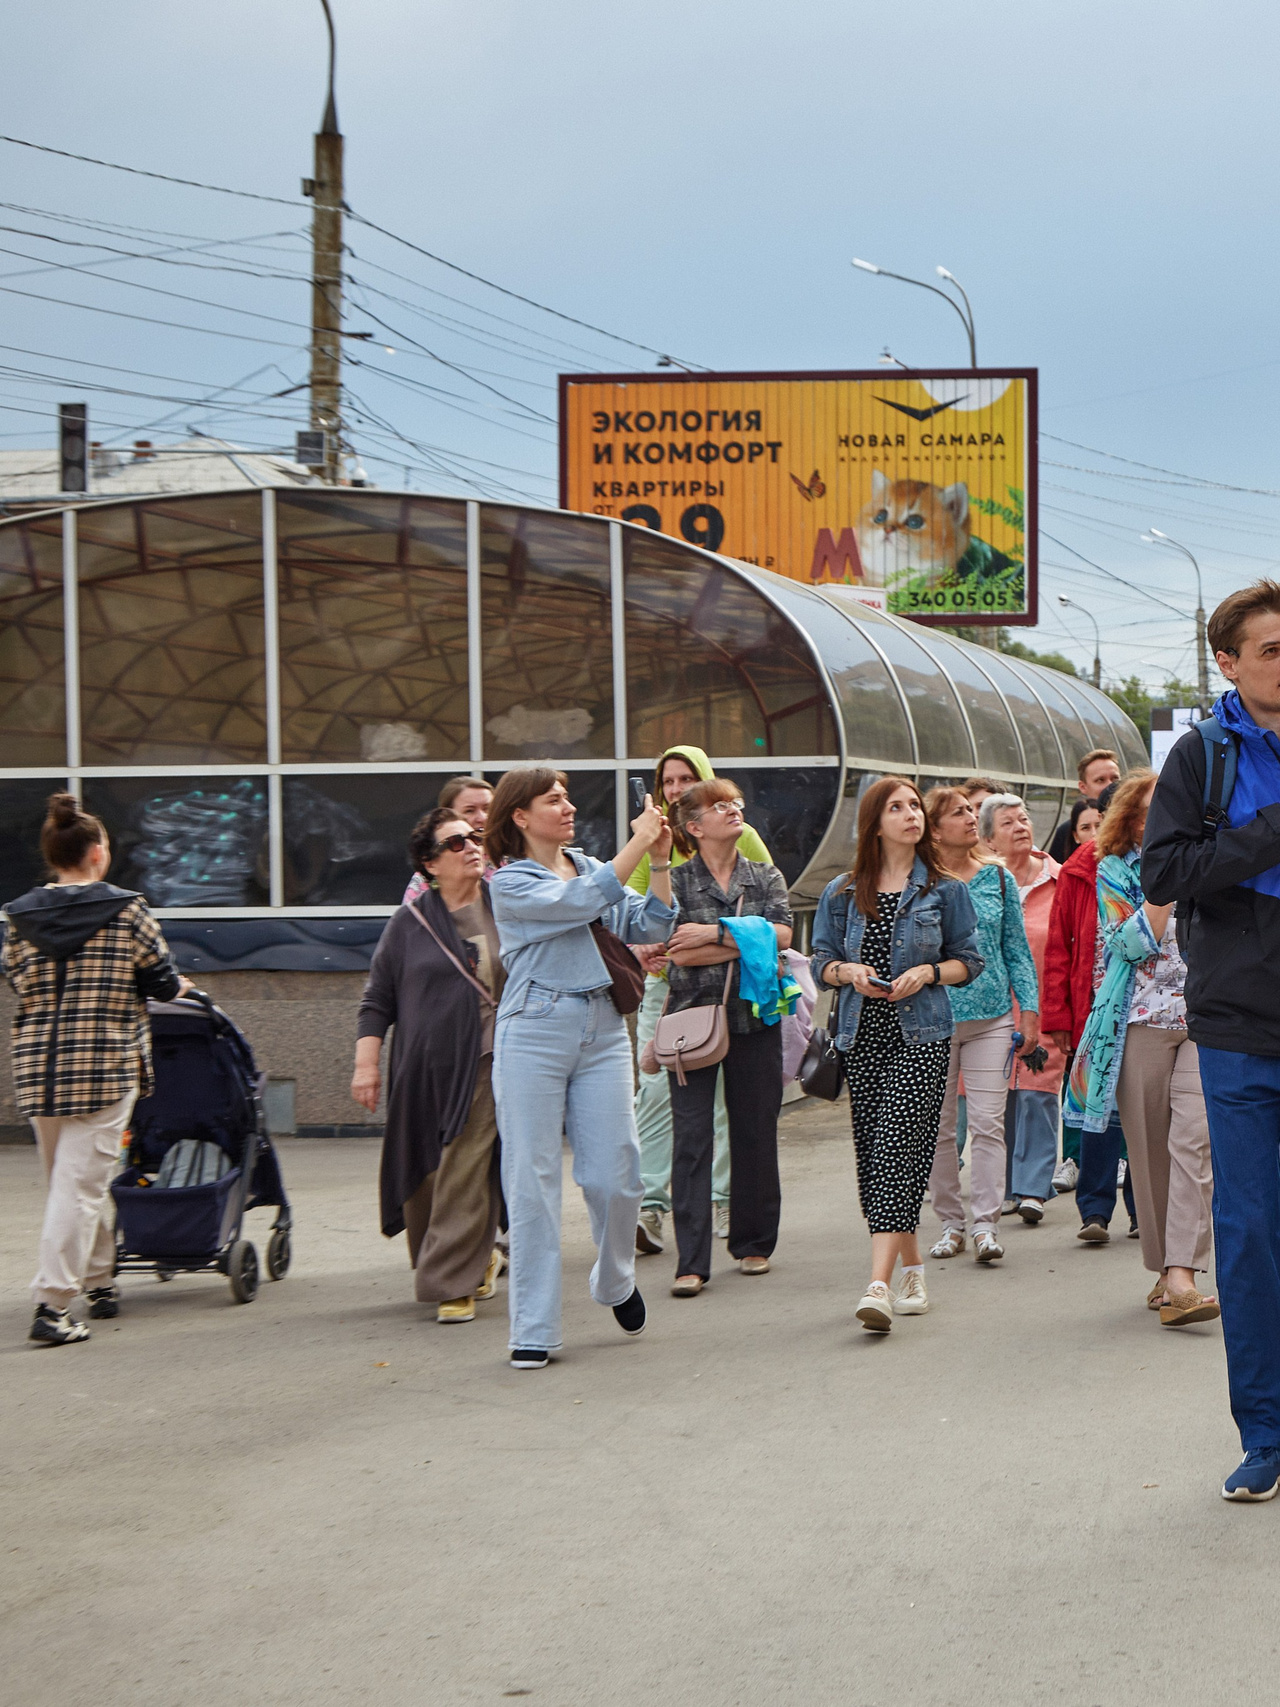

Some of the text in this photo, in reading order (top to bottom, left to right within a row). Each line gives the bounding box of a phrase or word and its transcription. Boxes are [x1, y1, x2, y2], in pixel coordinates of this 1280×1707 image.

[592, 410, 762, 433] ЭКОЛОГИЯ
[838, 433, 1006, 448] НОВАЯ САМАРА
[593, 441, 783, 465] И КОМФОРТ
[593, 480, 725, 498] КВАРТИРЫ
[593, 504, 614, 515] ОТ
[908, 591, 1008, 608] 340 05 05
